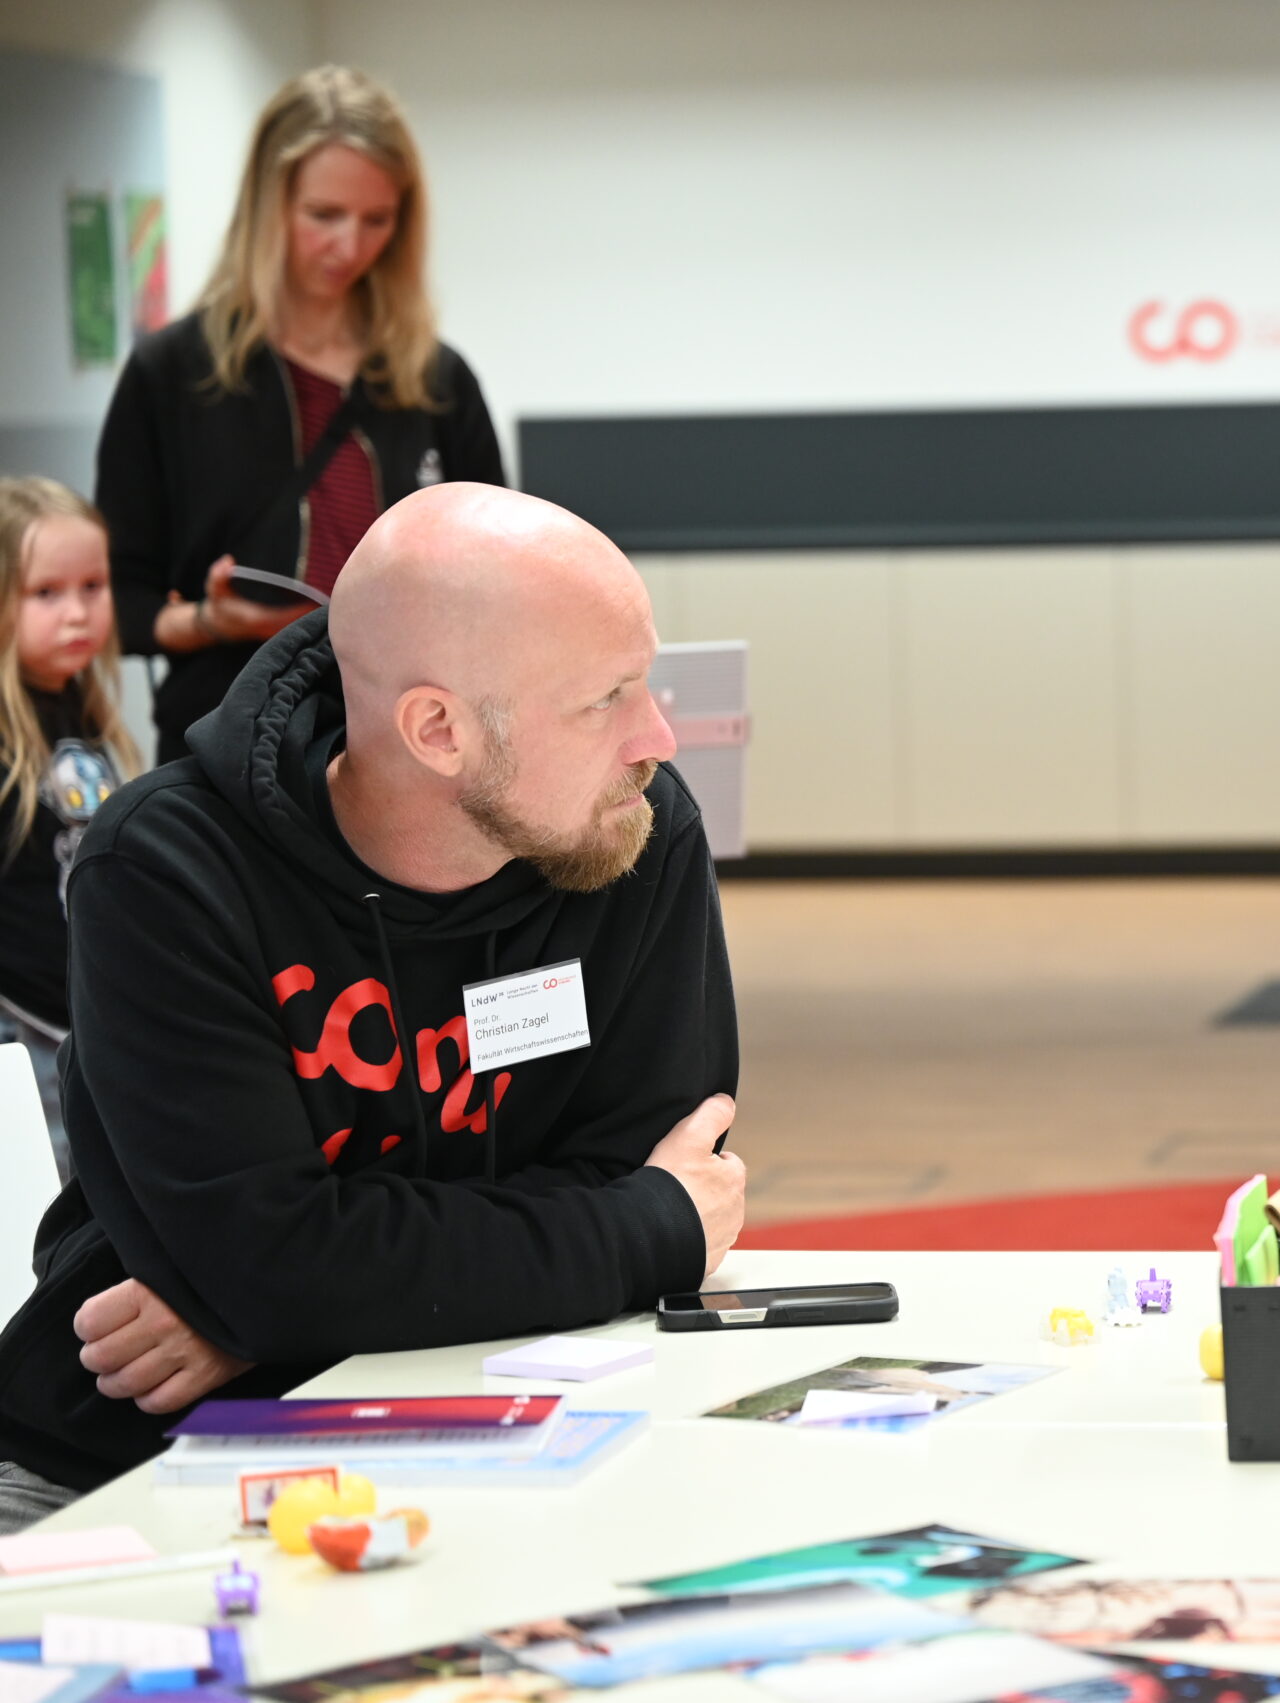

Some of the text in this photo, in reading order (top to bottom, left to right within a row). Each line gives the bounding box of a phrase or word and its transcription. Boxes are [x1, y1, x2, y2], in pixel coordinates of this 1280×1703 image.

[471, 993, 498, 1008] LNdW
[473, 1014, 501, 1026] Prof. Dr.
[475, 1012, 550, 1041] Christian Zagel
[477, 1029, 589, 1062] Fakultät Wirtschaftswissenschaften
